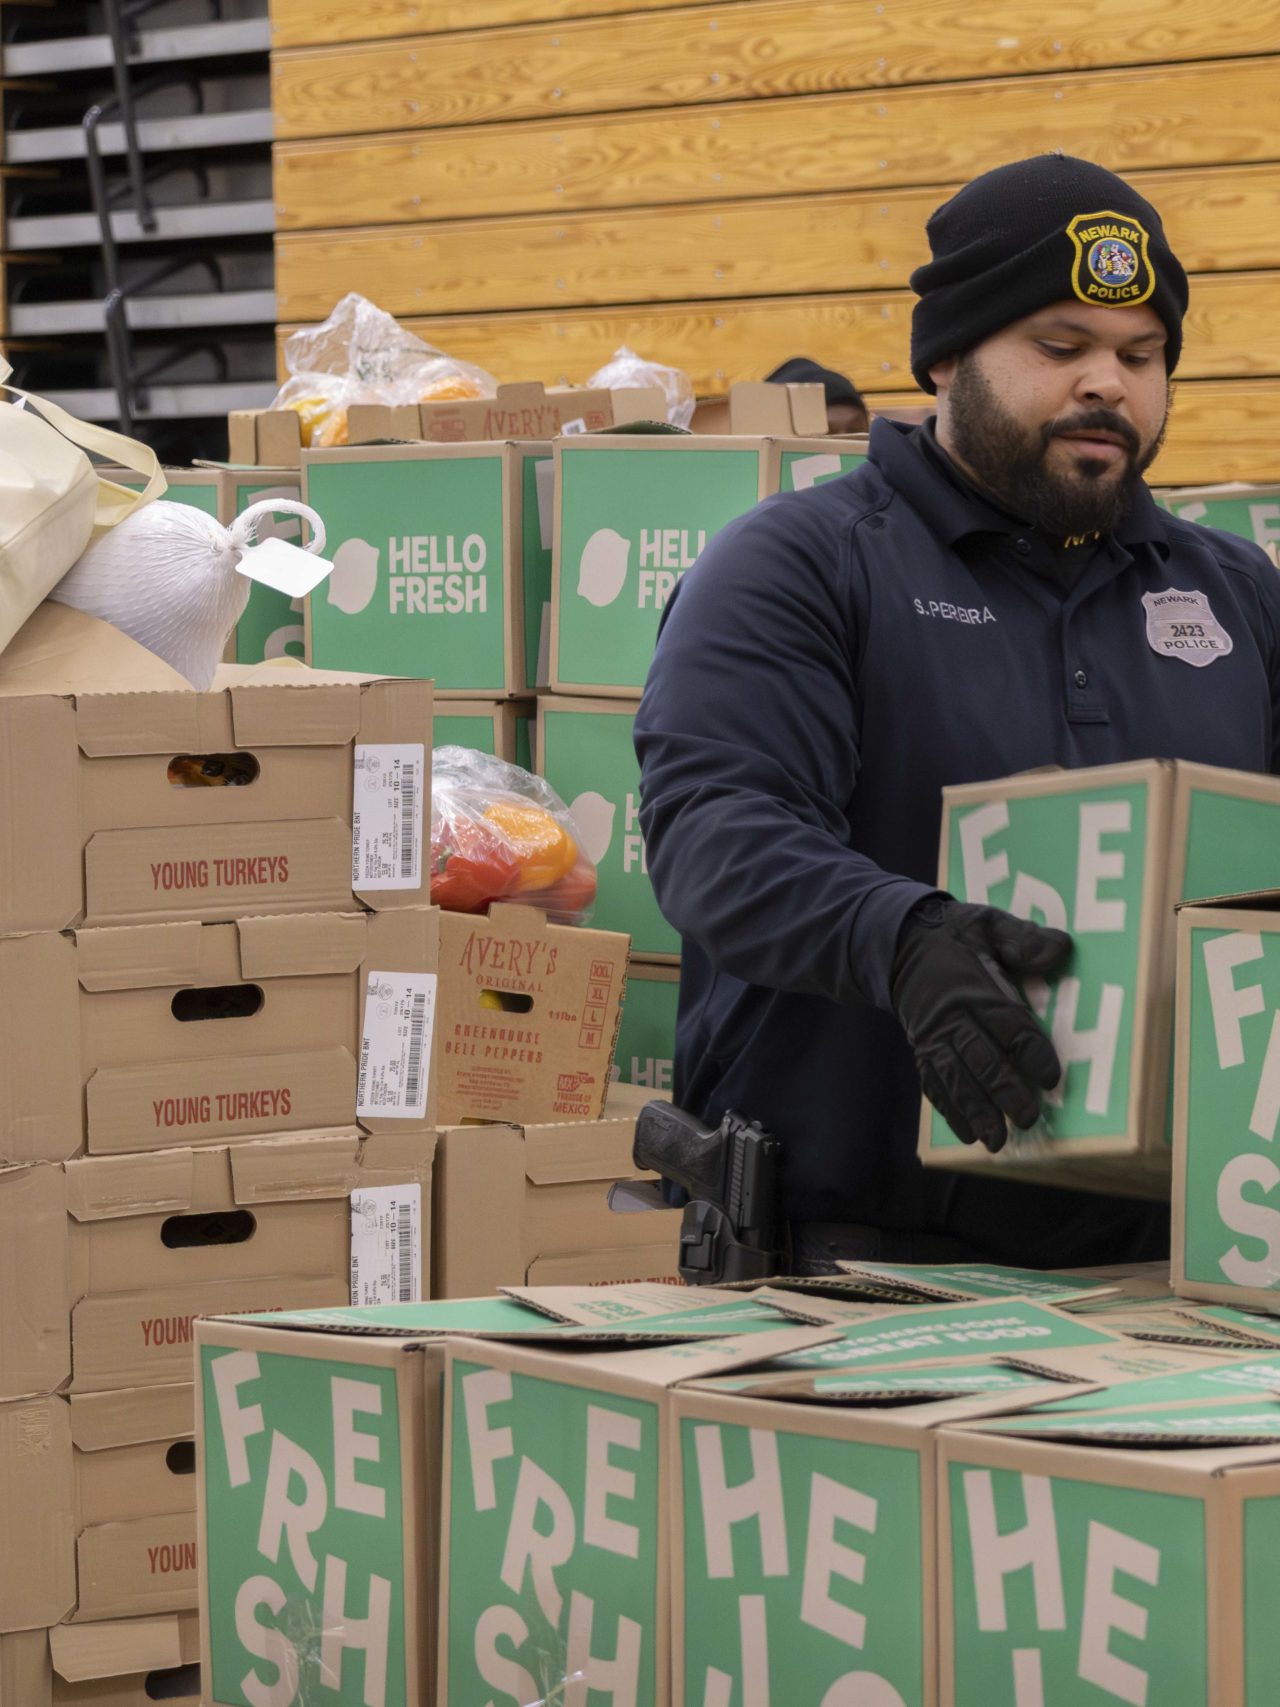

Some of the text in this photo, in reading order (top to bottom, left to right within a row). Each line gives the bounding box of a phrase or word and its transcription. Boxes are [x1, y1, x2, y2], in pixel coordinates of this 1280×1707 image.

[1078, 225, 1140, 243] NEWARK
[1087, 284, 1140, 299] POLICE
[484, 405, 559, 440] AVERY'S
[389, 533, 487, 574] HELLO
[389, 574, 488, 615] FRESH
[1153, 595, 1201, 607] NEWARK
[1170, 624, 1205, 638] 2423
[1163, 639, 1219, 650] POLICE
[151, 856, 288, 890] YOUNG TURKEYS
[459, 931, 558, 976] AVERY'S
[592, 966, 609, 978] XXL
[476, 973, 544, 993] ORIGINAL
[592, 989, 604, 1001] XL
[591, 1010, 597, 1022] L
[454, 1024, 541, 1046] GREENHOUSE
[586, 1032, 595, 1045] M
[361, 1052, 369, 1070] PRIDE
[445, 1041, 543, 1064] BELL PEPPERS
[358, 1073, 368, 1106] NORTHERN
[153, 1088, 291, 1127] YOUNG TURKEYS
[552, 1101, 591, 1116] MEXICO
[148, 1543, 196, 1573] YOUN
